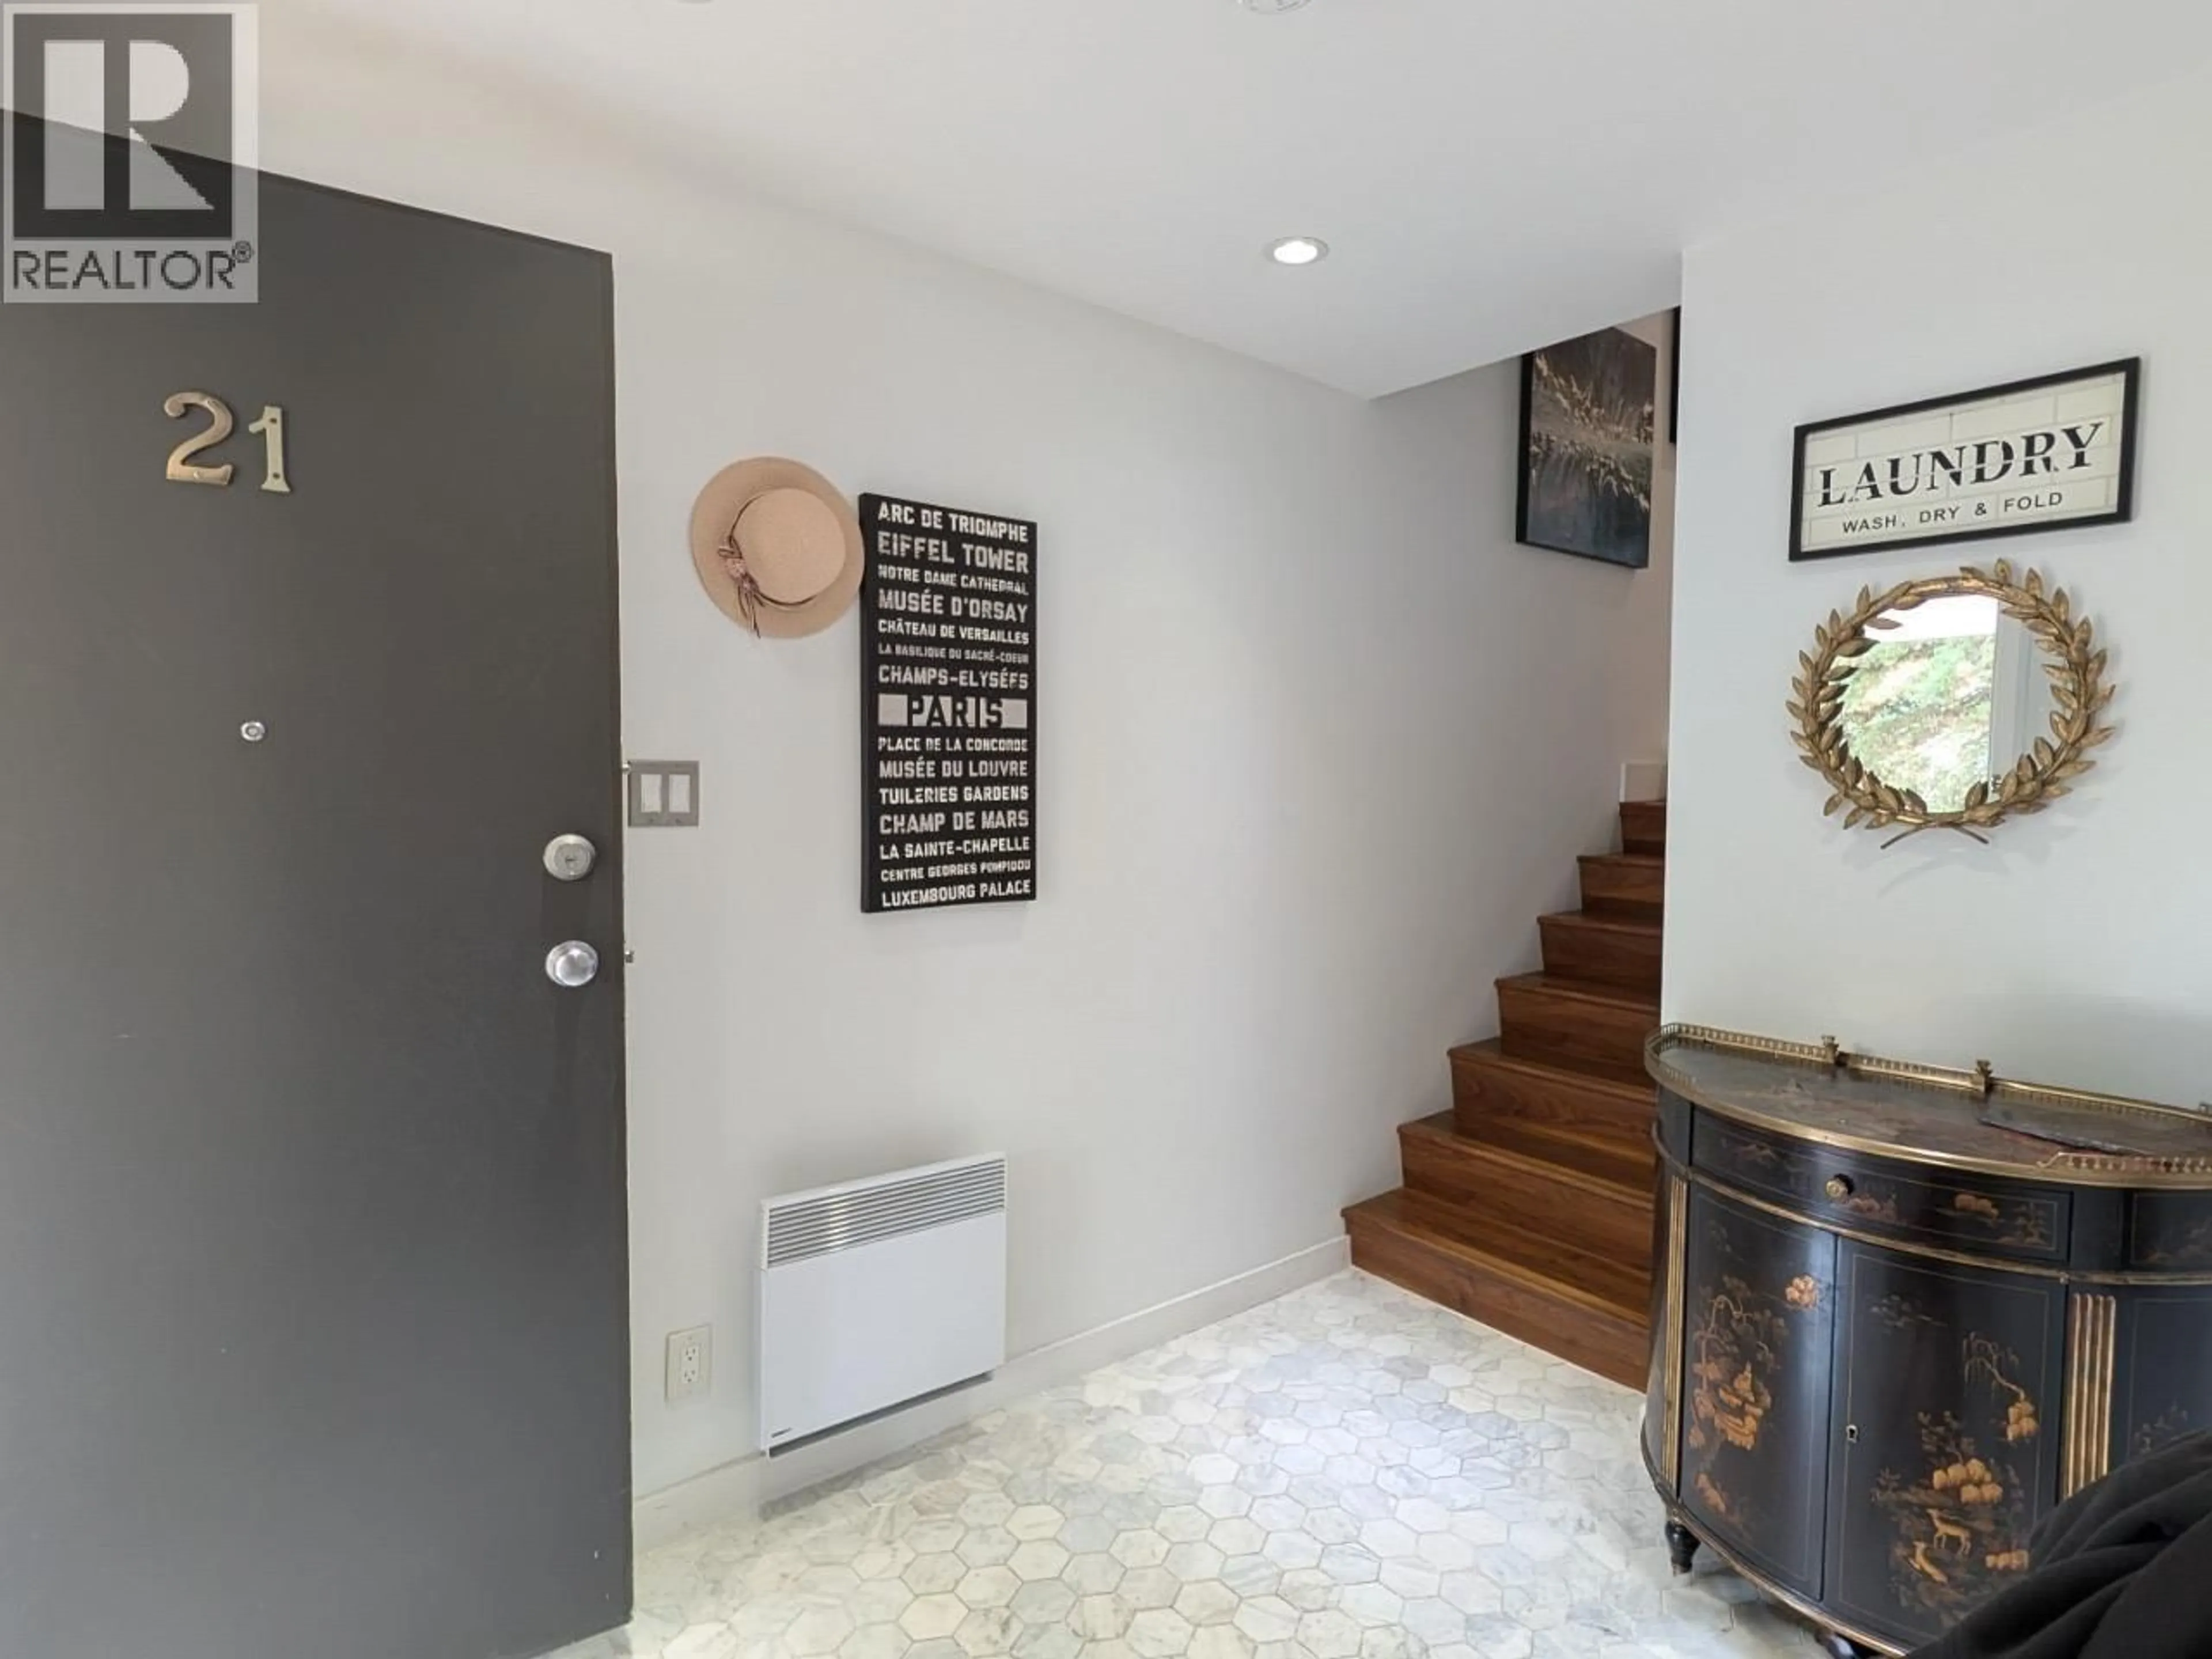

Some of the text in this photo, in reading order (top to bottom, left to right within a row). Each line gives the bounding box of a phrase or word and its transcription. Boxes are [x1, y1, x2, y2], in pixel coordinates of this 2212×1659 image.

[164, 391, 290, 493] 21
[1817, 421, 2104, 507] LAUNDRY
[877, 501, 1029, 543] ARC DE TRIOMPHE
[1919, 506, 1961, 525] DRY
[1975, 502, 1987, 516] &
[2004, 491, 2063, 512] FOLD
[877, 531, 1029, 574] EIFFEL TOWER
[877, 564, 1029, 596] NOTRE DAME CATHEDRAL
[878, 588, 1028, 623] MUSÉE D'ORSAY
[878, 618, 1029, 645] CHÂTEAU DE VERSAILLES
[878, 642, 892, 654] LA
[895, 643, 946, 658] BASILIQUE
[949, 648, 962, 660] DU
[907, 695, 1002, 728] PARIS
[877, 736, 1028, 752] PLACE DE LA CONCORDE
[879, 756, 1028, 778] MUSÉE DU LOUVRE
[878, 785, 1029, 805] TUILERIES GARDENS
[879, 810, 1029, 835] CHAMP DE MARS
[879, 836, 1030, 860] LA SAINTE-CHAPELLE
[881, 859, 1031, 882] CENTRE GEORGES POMPIDOU
[881, 879, 1031, 908] LUXEMBOURG PALACE
